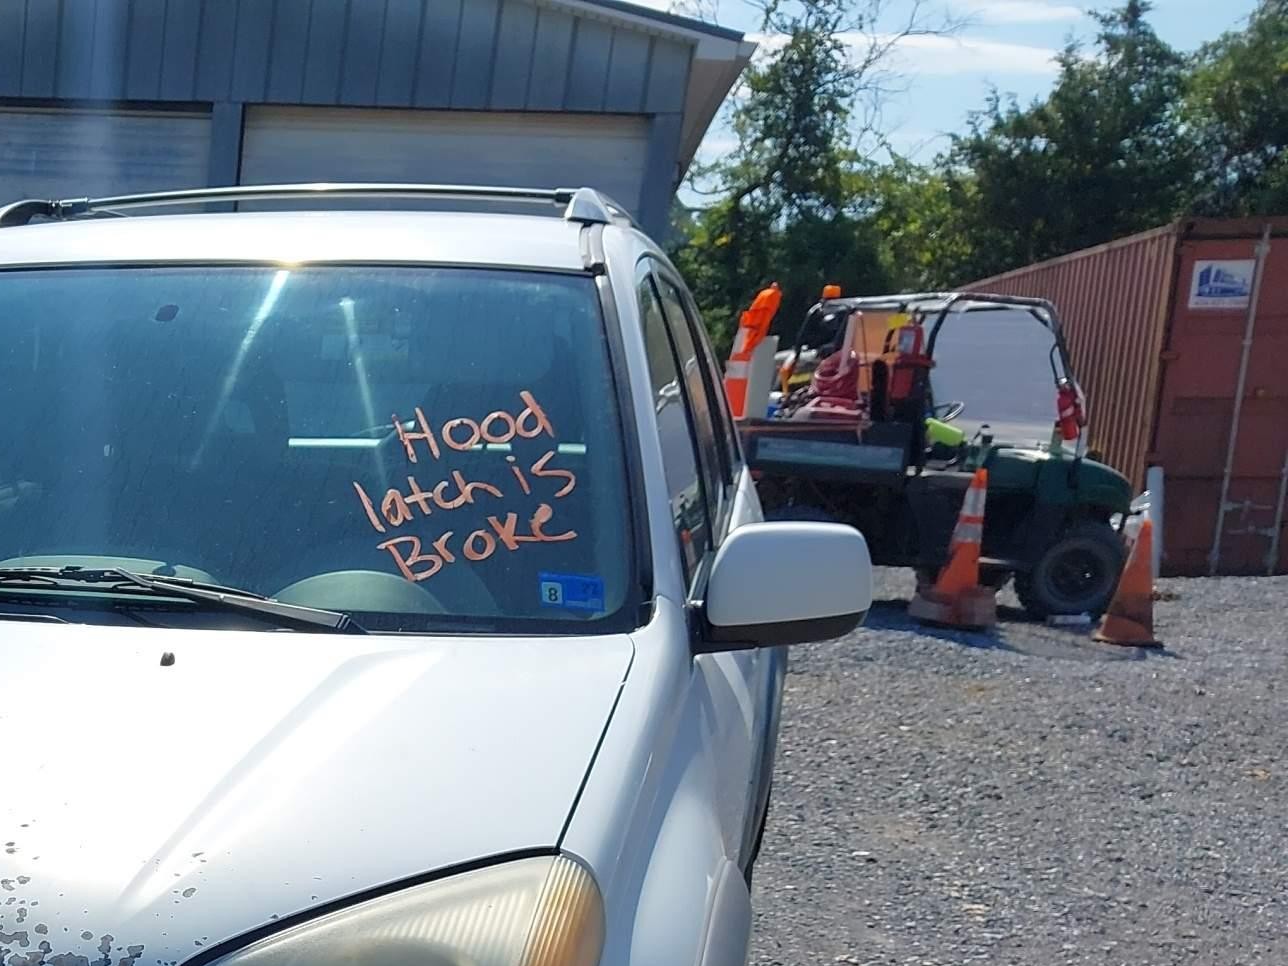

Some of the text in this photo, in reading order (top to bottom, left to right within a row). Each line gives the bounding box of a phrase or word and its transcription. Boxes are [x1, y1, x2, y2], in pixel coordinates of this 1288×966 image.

[391, 390, 555, 463] Hood
[353, 470, 504, 533] latch
[376, 503, 578, 581] Broke
[548, 587, 559, 602] 8
